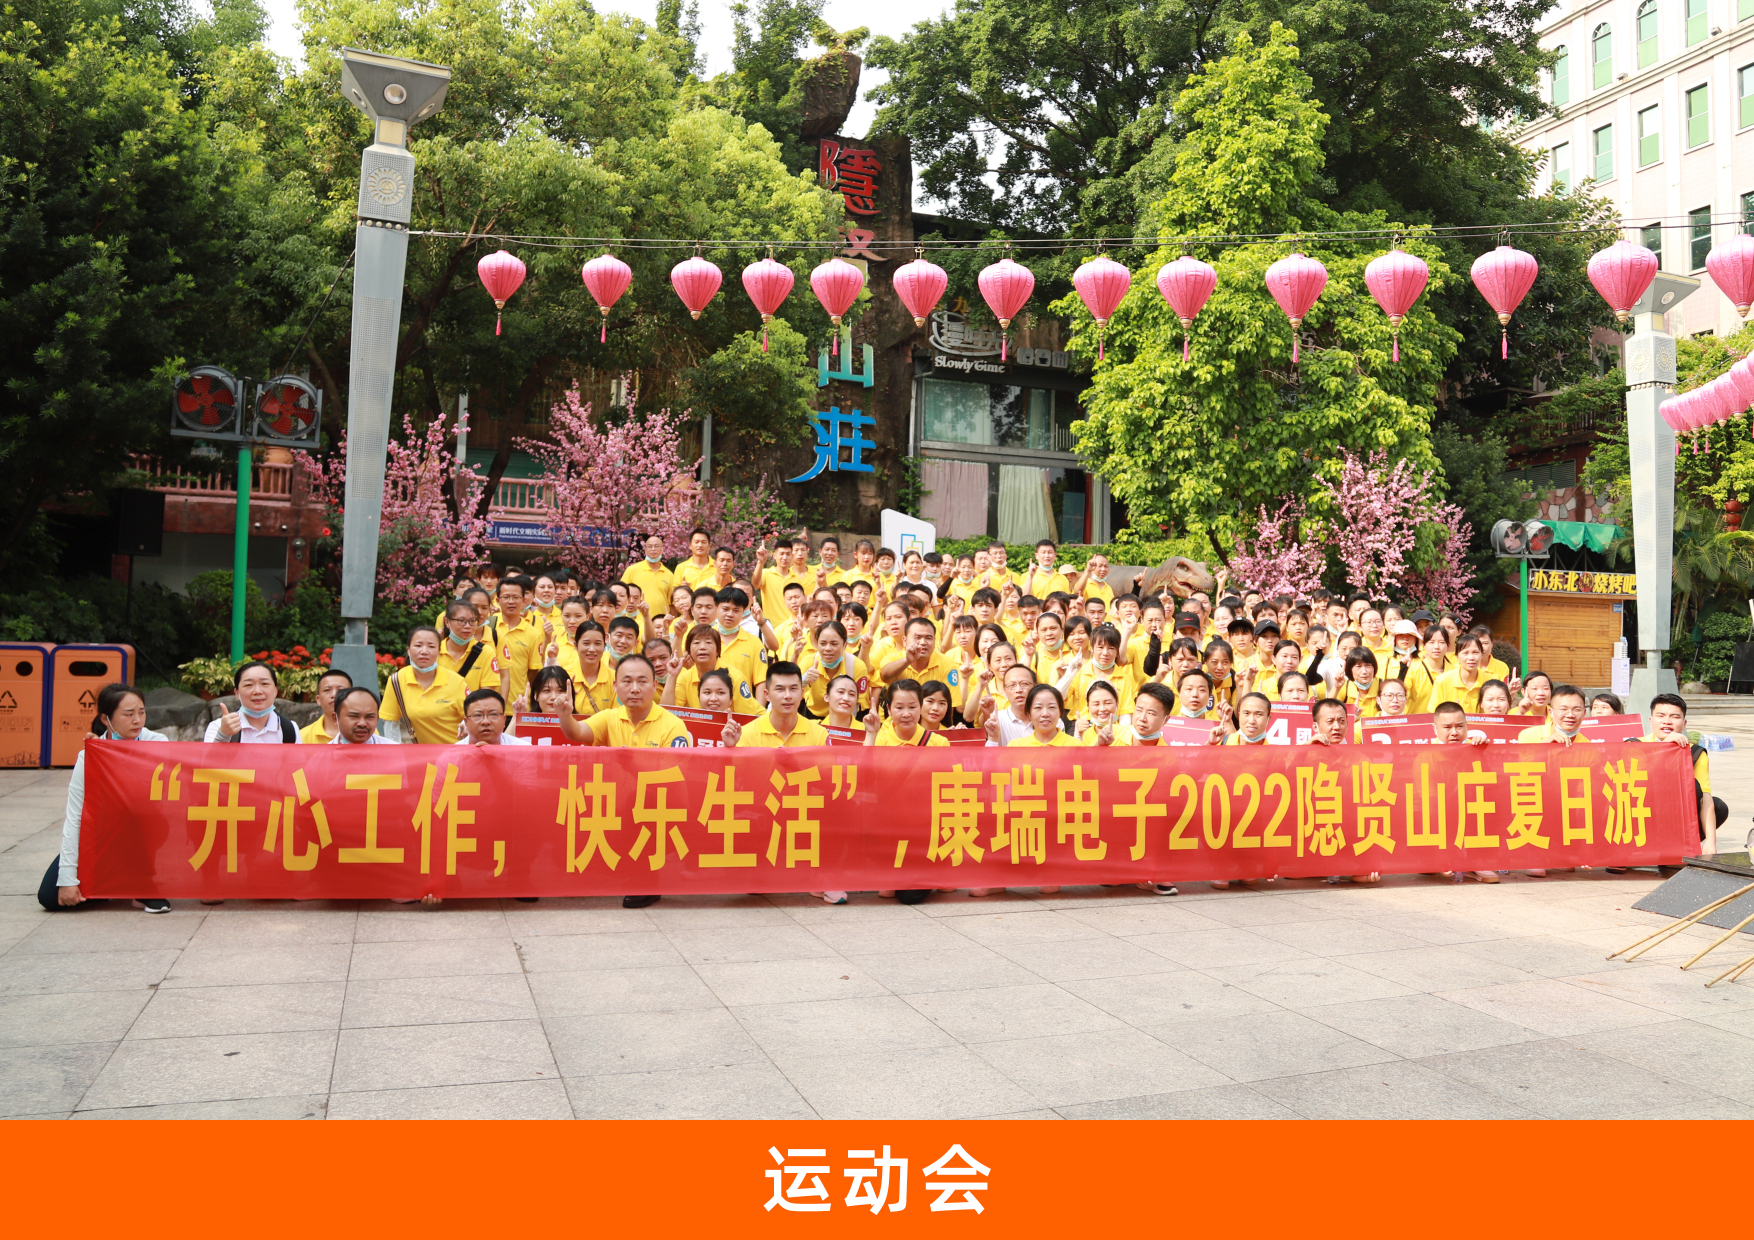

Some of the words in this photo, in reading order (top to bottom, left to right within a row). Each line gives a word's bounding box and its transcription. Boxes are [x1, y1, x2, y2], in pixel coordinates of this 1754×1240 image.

[786, 139, 891, 483] 隱山莊
[1532, 569, 1579, 592] 小东北
[1592, 573, 1637, 594] 烧烤吧
[860, 680, 866, 691] 9
[951, 672, 958, 684] 8
[741, 683, 751, 697] 10
[1266, 718, 1291, 745] 4
